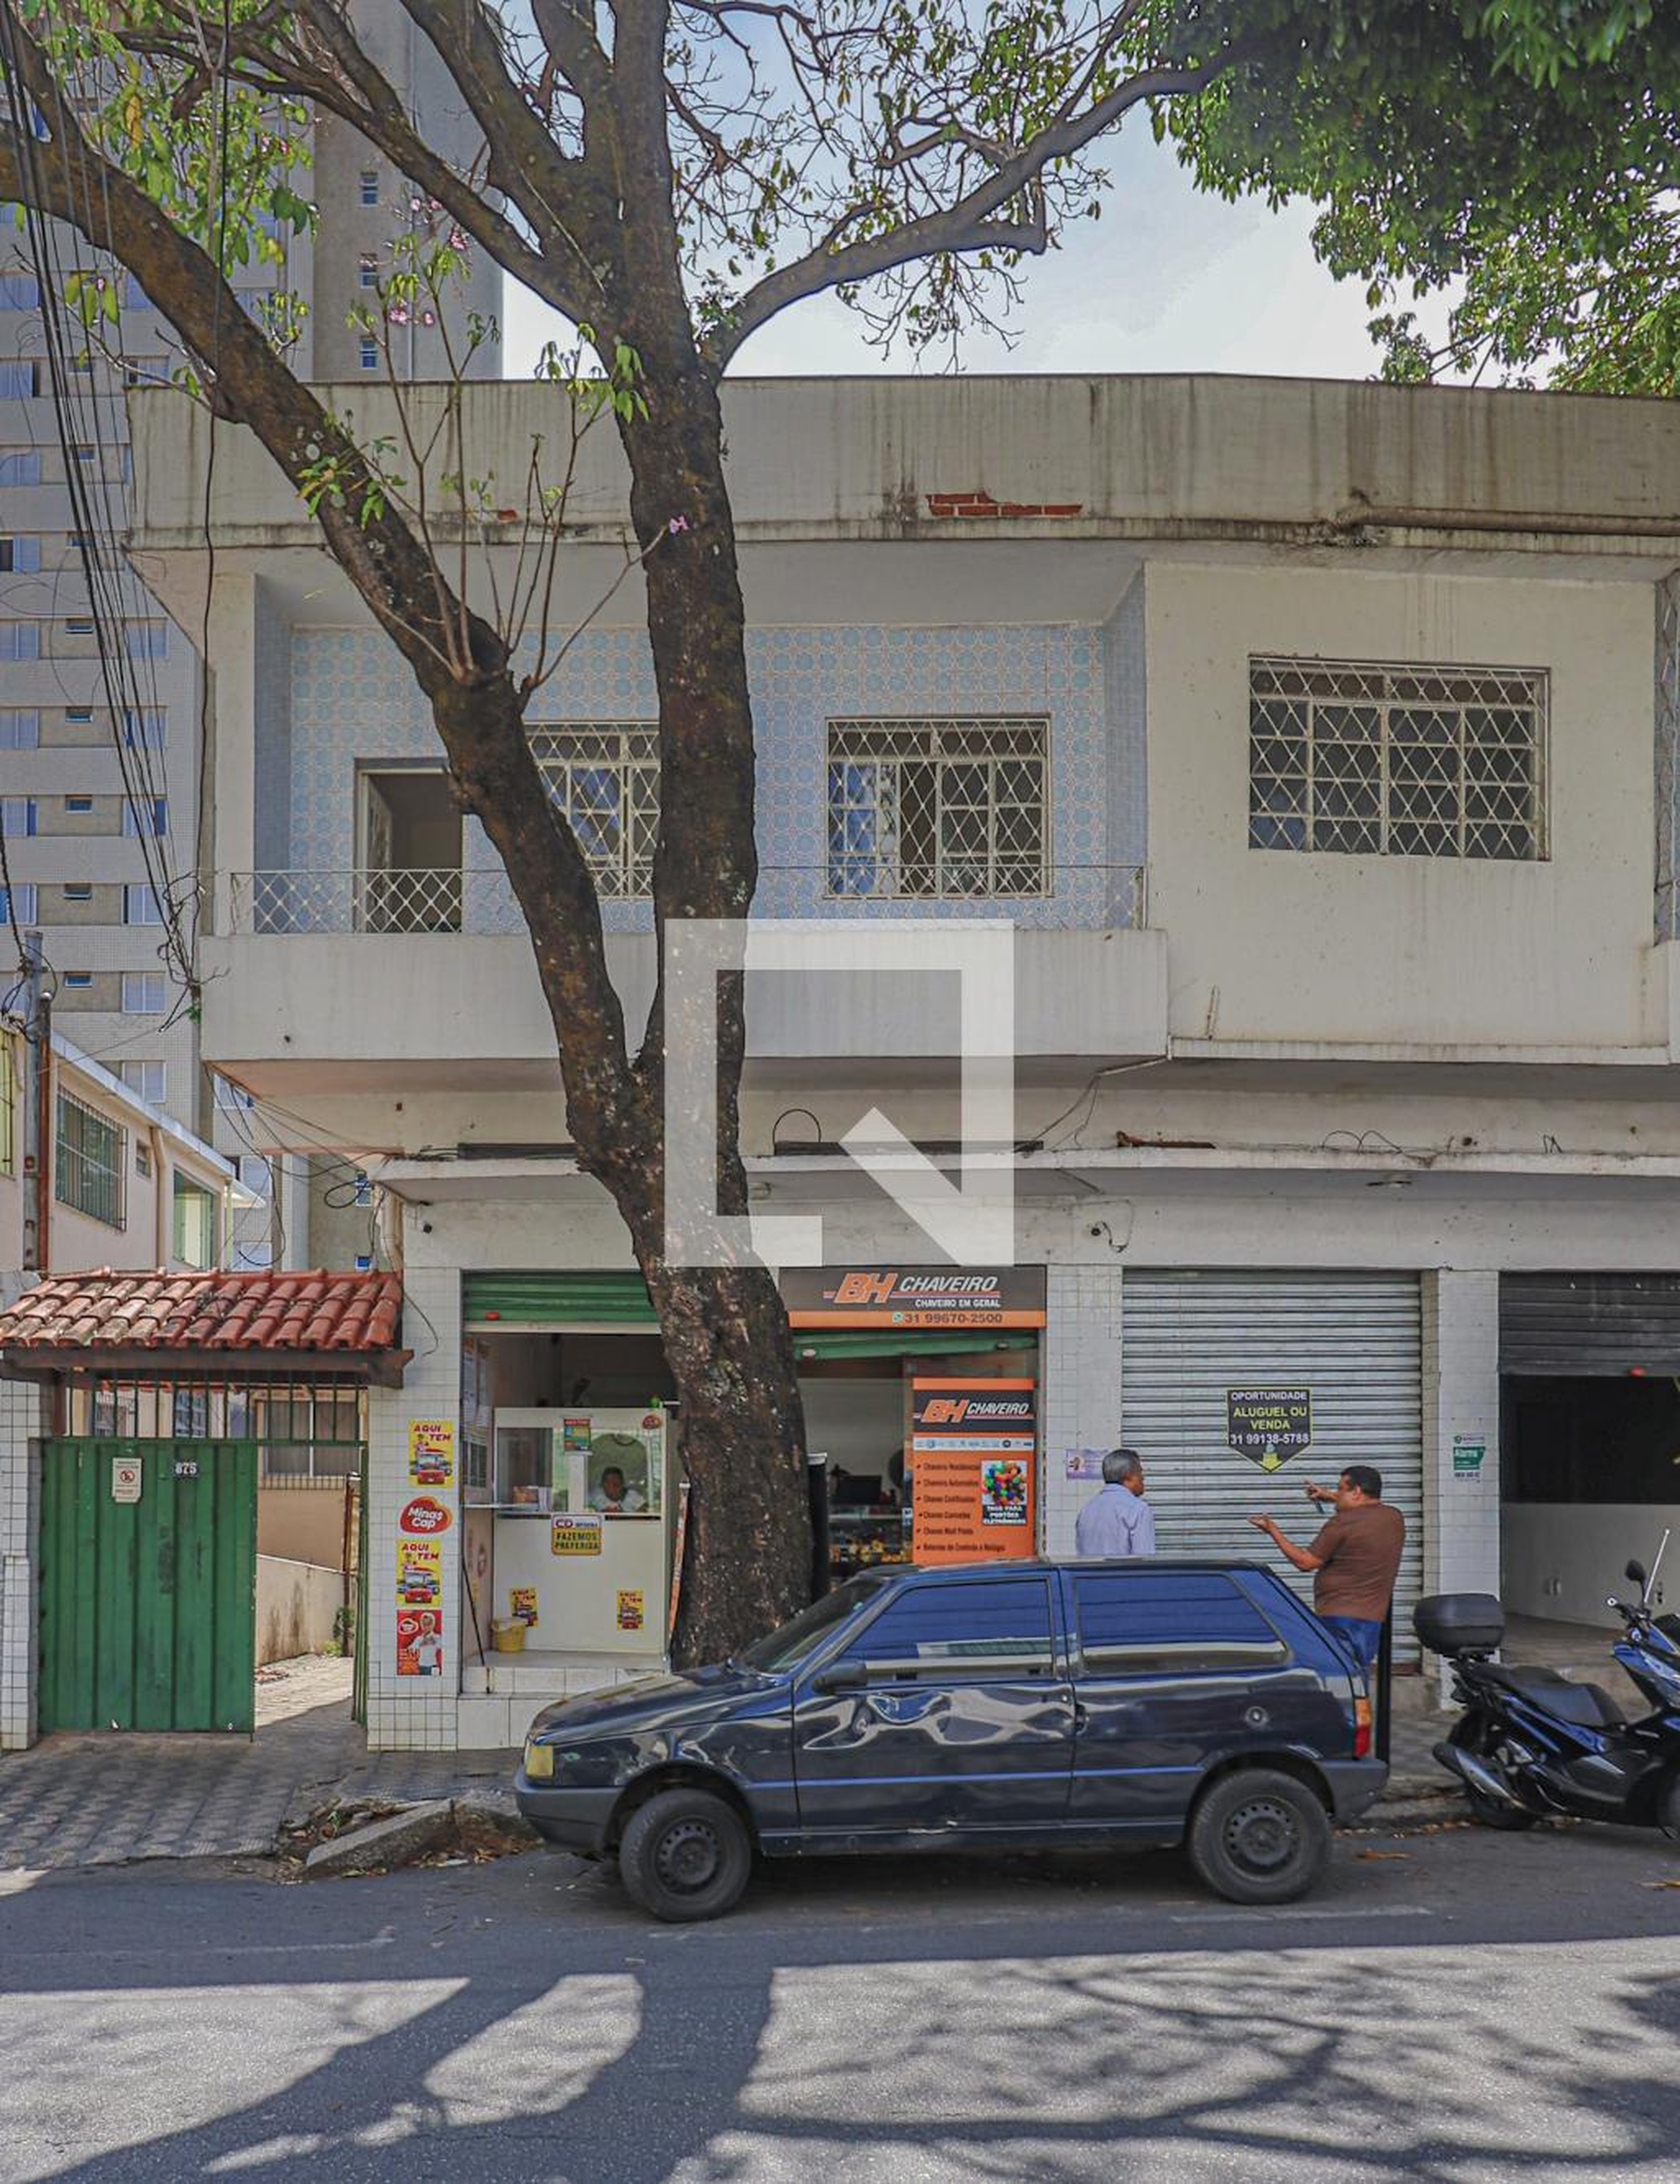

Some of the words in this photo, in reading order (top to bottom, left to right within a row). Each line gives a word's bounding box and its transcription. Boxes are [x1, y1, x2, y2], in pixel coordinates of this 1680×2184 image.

[834, 1273, 898, 1303] BH
[900, 1276, 998, 1291] CHAVEIRO
[915, 1299, 956, 1308] CHAVEIRO
[958, 1299, 972, 1308] EM
[973, 1299, 1001, 1308] GERAL
[905, 1314, 919, 1323] 31
[1231, 1391, 1307, 1401] OPORTUNIDADE
[920, 1399, 970, 1423] BH
[967, 1402, 1029, 1415] CHAVEIRO
[1233, 1407, 1288, 1417] ALUGUEL
[1290, 1406, 1307, 1416] OU
[1250, 1420, 1290, 1430] VENDA
[1230, 1434, 1243, 1444] 31
[411, 1517, 436, 1530] Cap
